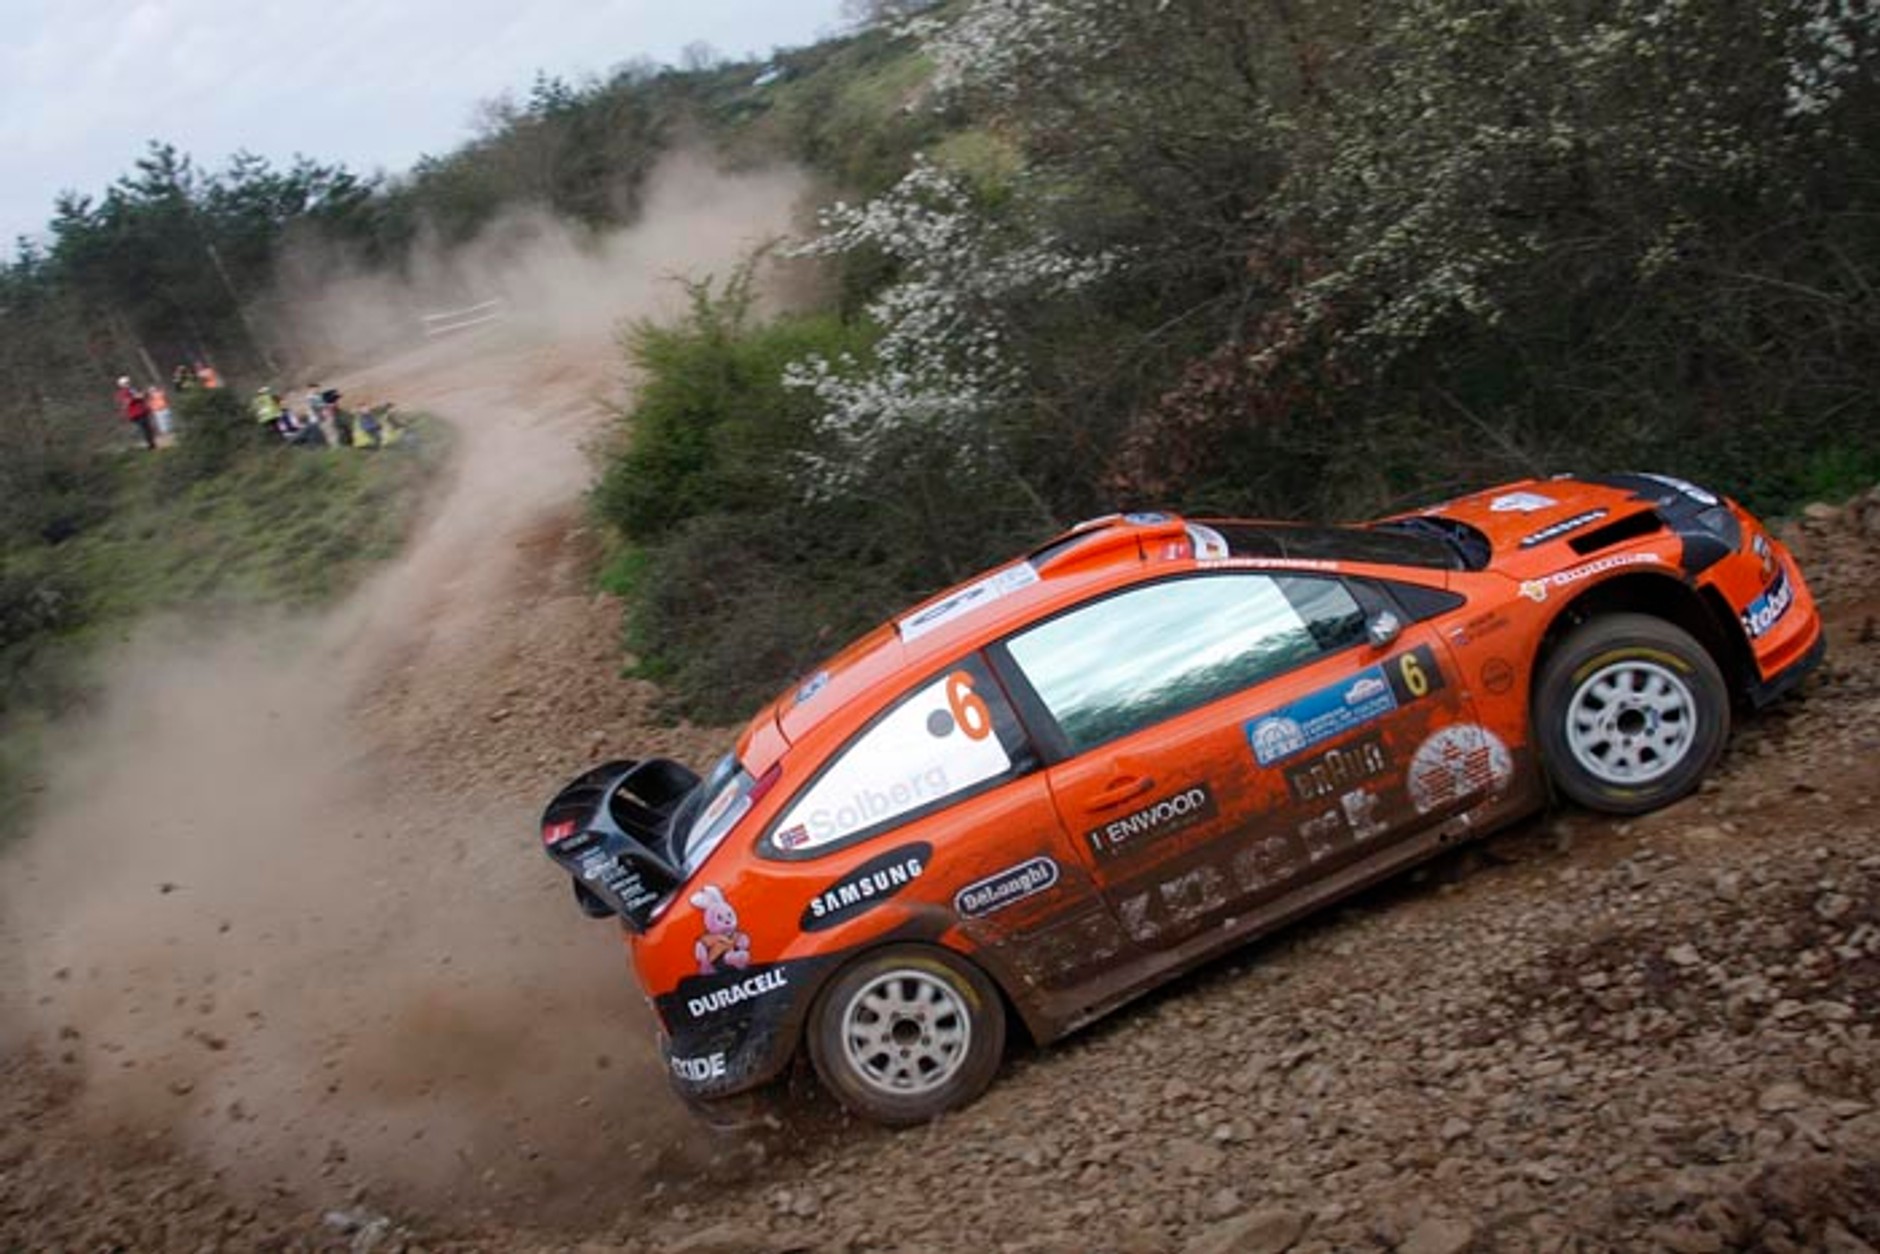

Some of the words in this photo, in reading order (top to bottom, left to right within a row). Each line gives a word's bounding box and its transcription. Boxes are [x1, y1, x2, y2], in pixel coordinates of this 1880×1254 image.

[1400, 652, 1428, 697] 6
[946, 670, 991, 741] 6
[809, 765, 948, 842] Solberg
[810, 858, 922, 917] SAMSUNG
[687, 967, 788, 1017] DURACELL
